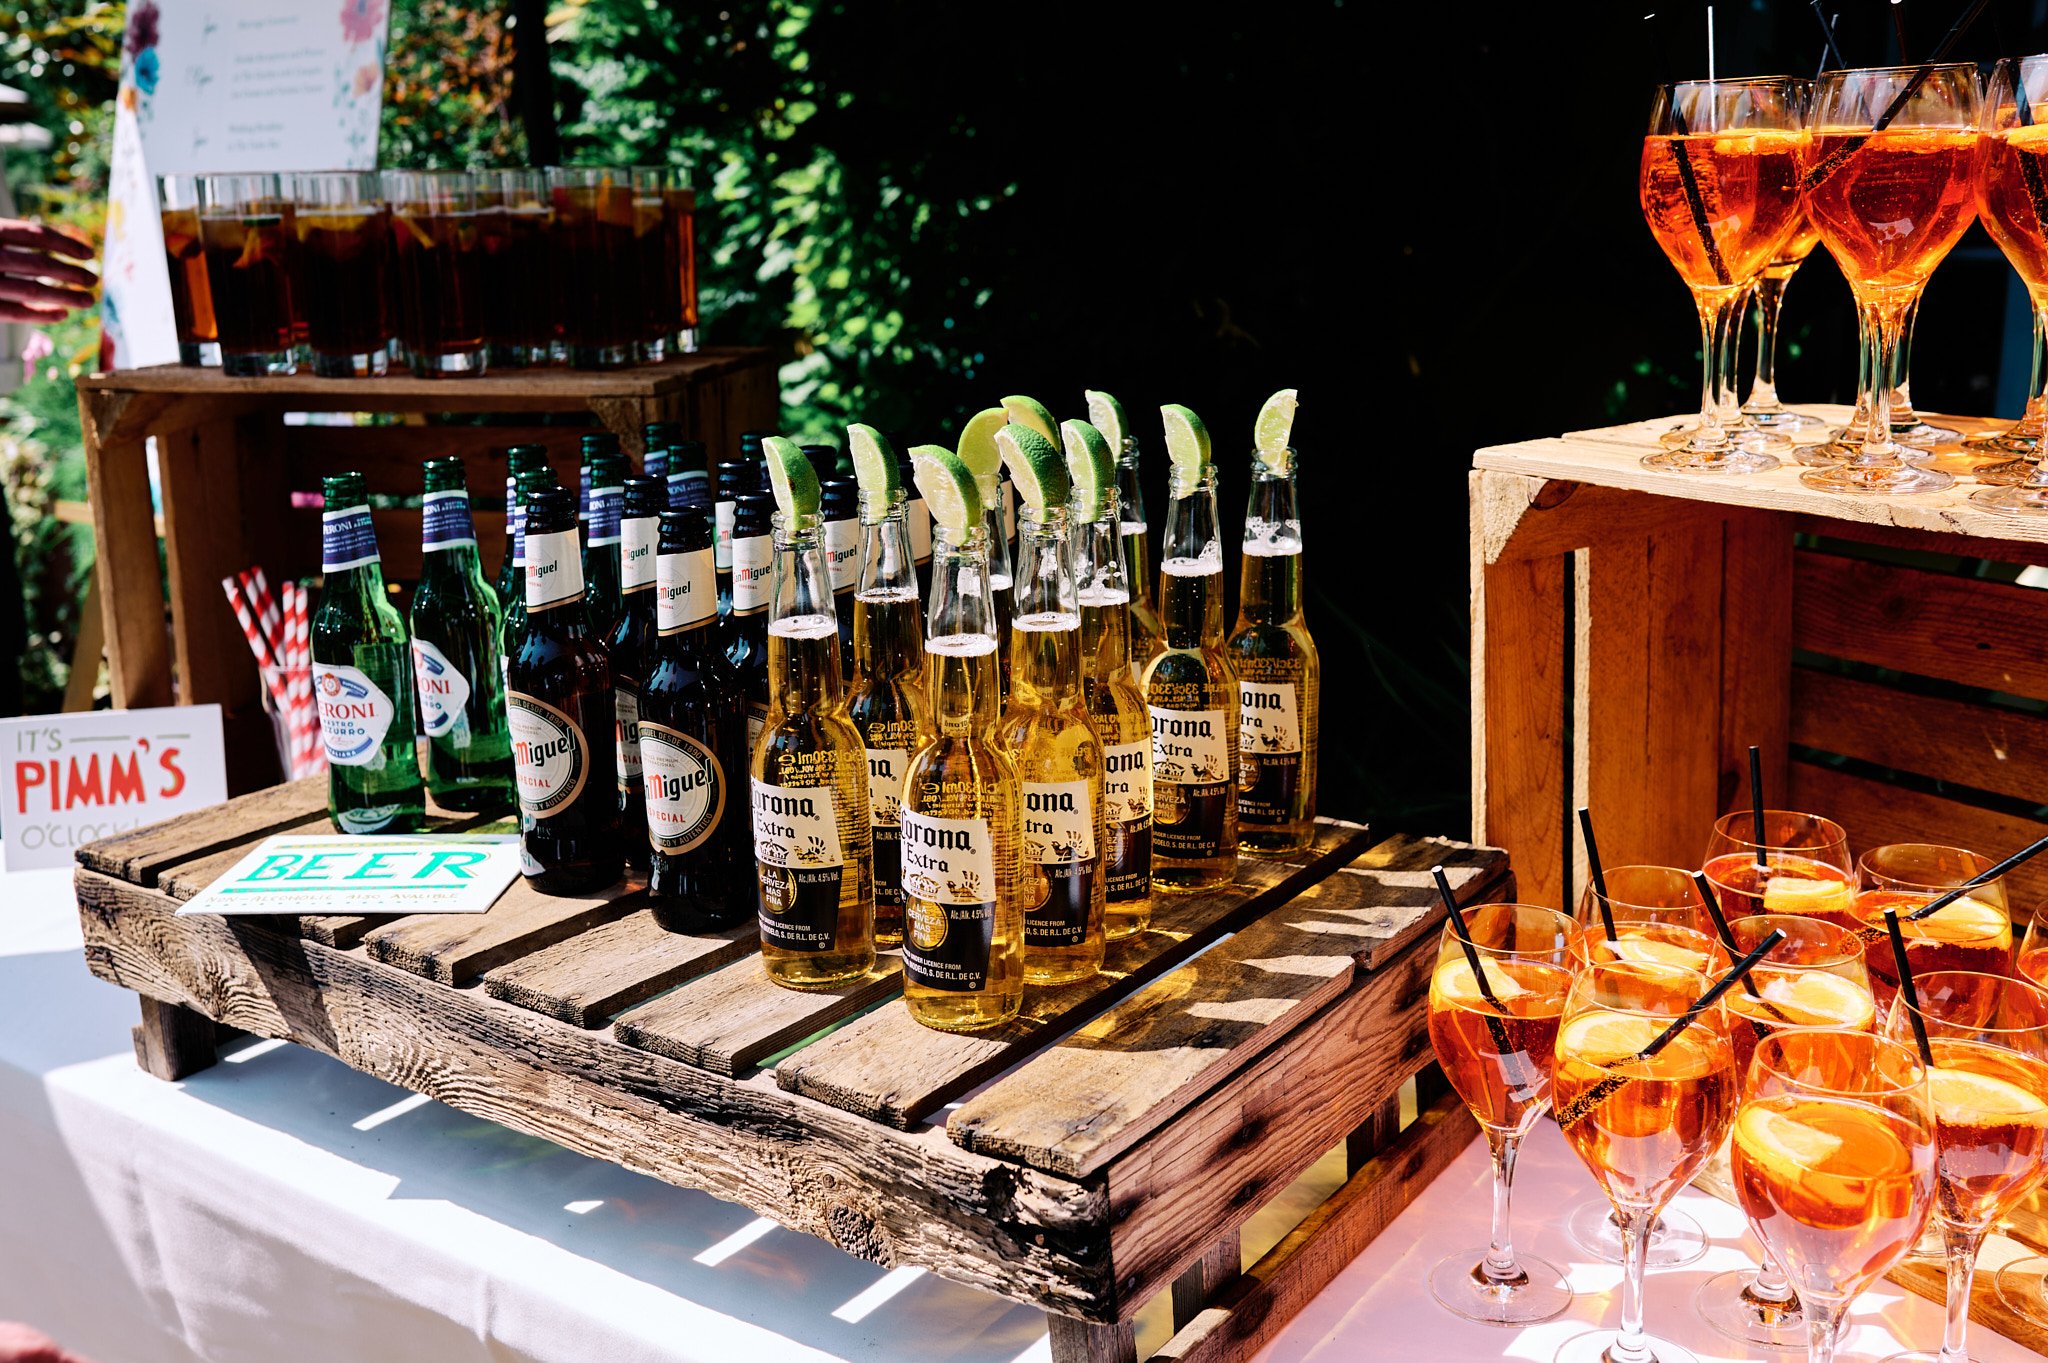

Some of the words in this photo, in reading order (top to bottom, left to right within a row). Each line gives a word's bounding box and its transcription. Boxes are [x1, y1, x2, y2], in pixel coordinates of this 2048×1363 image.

[528, 560, 557, 578] Miguel
[660, 581, 690, 600] Miguel
[421, 677, 450, 695] ONI
[1241, 691, 1282, 710] ona
[545, 712, 564, 728] 1890
[1152, 716, 1212, 739] orona
[1240, 714, 1263, 728] tra
[17, 728, 62, 753] IT'S
[515, 727, 577, 768] Miguel
[683, 743, 703, 760] 1890
[1106, 751, 1144, 774] ona
[15, 738, 186, 814] PIMM'S
[648, 757, 714, 802] Miguel
[752, 784, 816, 818] orona
[1023, 792, 1075, 813] ona
[1153, 793, 1186, 804] ERVEZA
[1024, 819, 1054, 835] tra
[906, 842, 949, 873] Extra
[236, 851, 490, 882] BEER
[767, 869, 778, 880] LA
[760, 874, 791, 890] CERVEZA
[765, 888, 782, 899] MAS
[766, 894, 783, 906] FINA
[916, 903, 927, 913] LA
[776, 921, 795, 931] LICENCE
[796, 924, 811, 932] FROM
[914, 920, 931, 933] MAS
[1040, 928, 1049, 937] DE
[1063, 928, 1071, 936] DE
[787, 932, 795, 940] DE
[809, 933, 817, 941] DE
[914, 931, 931, 943] FINA
[924, 958, 944, 969] LICENCE
[945, 963, 961, 971] FROM
[928, 969, 935, 977] S.
[936, 970, 944, 979] DE
[945, 971, 958, 980] R.L.
[959, 972, 968, 981] DE
[969, 971, 981, 980] C.V.
